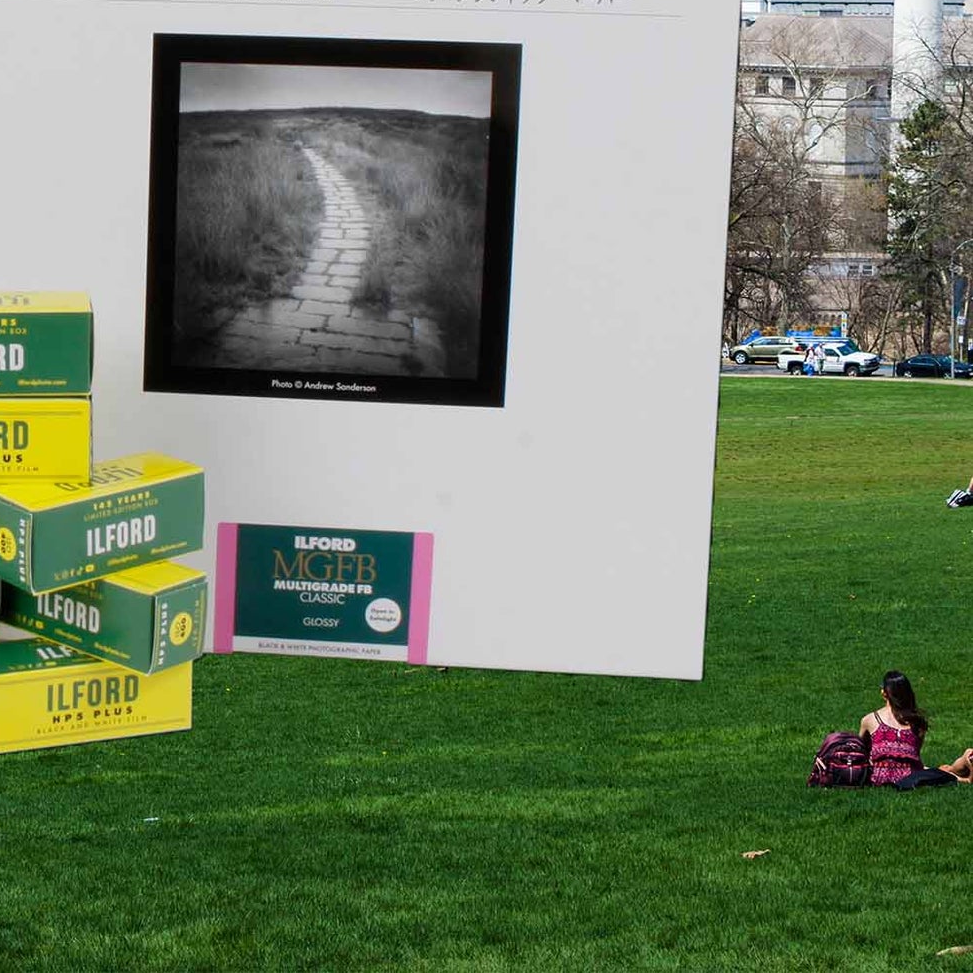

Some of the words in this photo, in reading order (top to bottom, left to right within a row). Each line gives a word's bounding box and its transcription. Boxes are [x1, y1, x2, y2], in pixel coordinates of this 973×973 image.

[271, 379, 293, 388] Photo
[304, 381, 334, 390] Andrew
[86, 514, 156, 557] ILFORD
[294, 535, 356, 552] ILFORD
[273, 549, 376, 584] MGFB
[273, 579, 356, 595] MULTIGRADE
[357, 583, 373, 595] FB
[299, 591, 346, 605] CLASSIC
[36, 592, 101, 634] ILFORD
[302, 616, 340, 627] GLOSSY
[46, 674, 140, 712] ILFORD
[52, 712, 84, 725] HP5
[93, 705, 133, 719] PLUS
